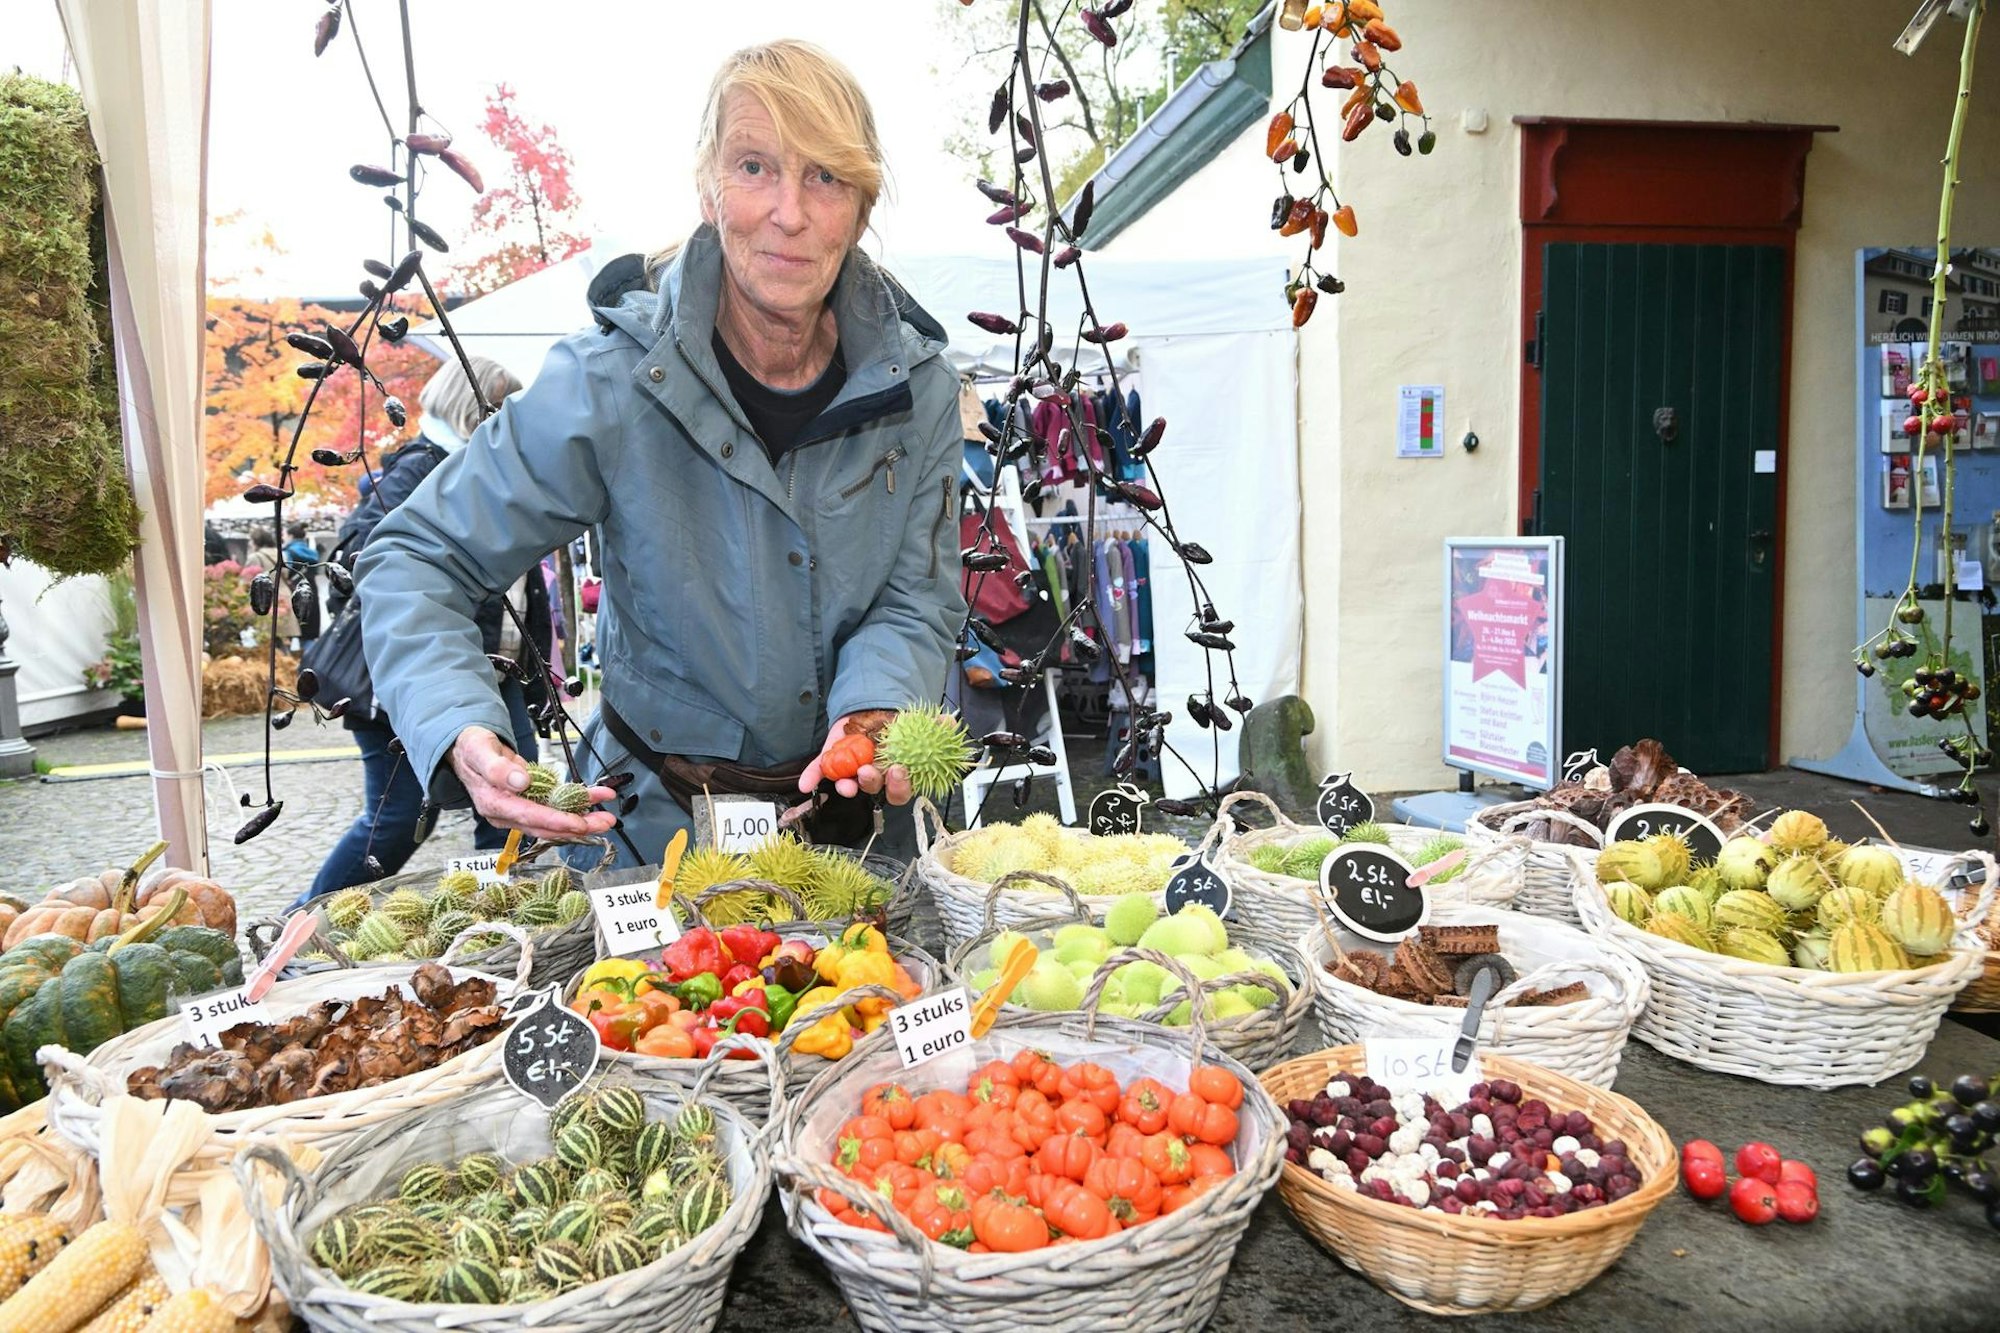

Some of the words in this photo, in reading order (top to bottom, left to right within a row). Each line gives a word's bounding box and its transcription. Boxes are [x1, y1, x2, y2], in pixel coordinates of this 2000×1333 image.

[1871, 331, 1914, 342] HERZLICH
[1915, 331, 1975, 342] WIOMMEN
[1977, 331, 1985, 340] IN
[1987, 329, 2000, 340] RÖ
[1467, 610, 1528, 625] Weihnachtsmarkt
[1106, 797, 1120, 813] 2
[1325, 791, 1337, 807] 2
[724, 817, 769, 840] 1,00
[1637, 819, 1650, 840] 2
[453, 860, 461, 872] 3
[467, 857, 497, 872] stuk
[1346, 859, 1364, 882] 2
[1367, 864, 1395, 886] St.
[1174, 877, 1188, 894] 2
[605, 894, 615, 908] 3
[617, 889, 652, 906] stuks
[614, 921, 625, 935] 1
[626, 917, 658, 933] euro
[190, 1006, 204, 1022] 3
[896, 1014, 909, 1033] 3
[913, 997, 964, 1027] stuks
[200, 1032, 214, 1049] 1
[517, 1025, 538, 1054] 5
[543, 1020, 574, 1048] St
[905, 1046, 918, 1064] 1
[922, 1029, 965, 1056] euro
